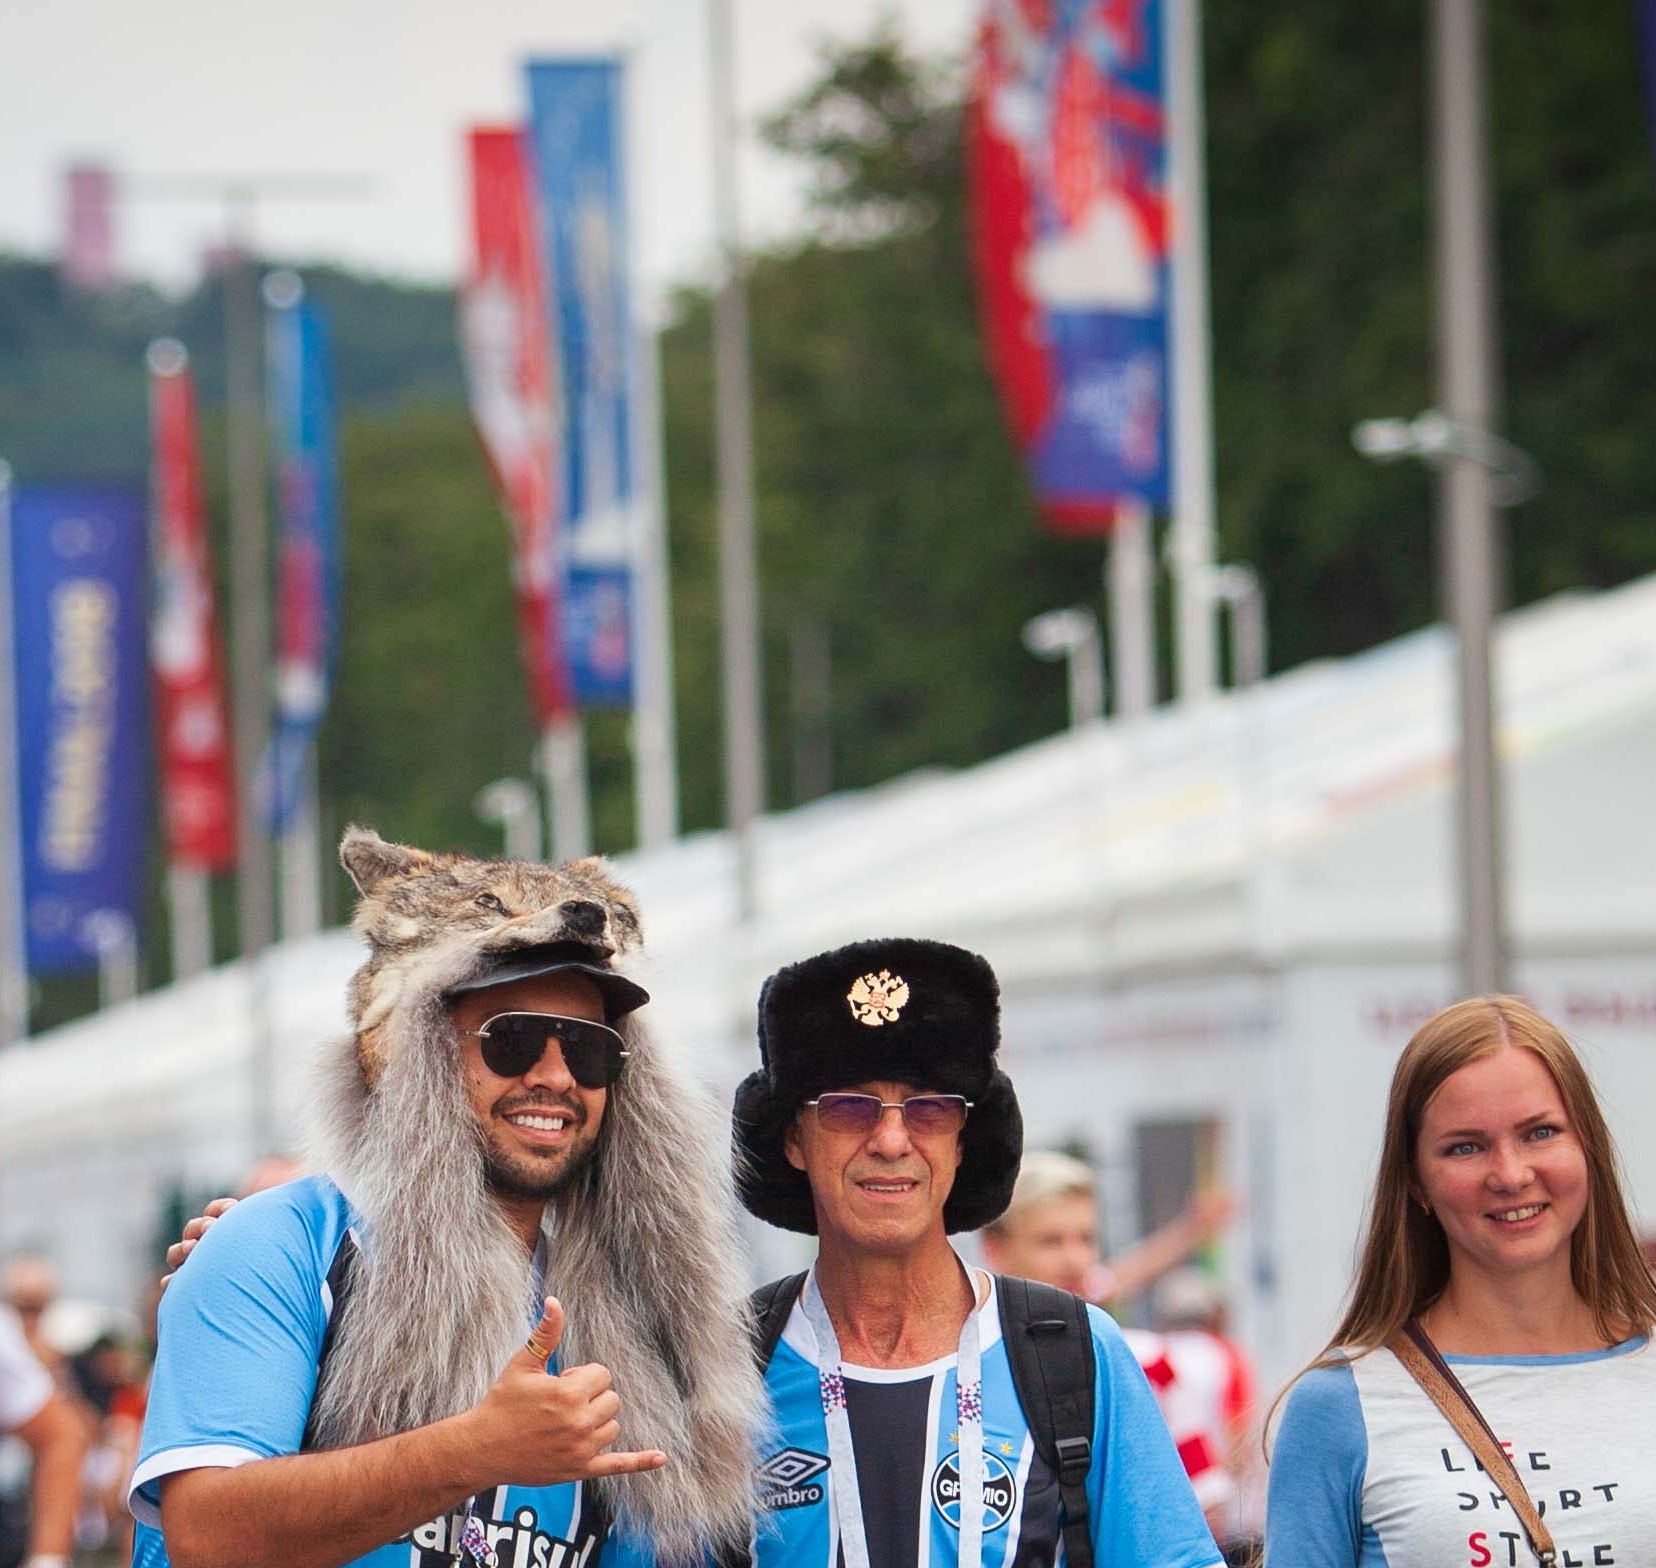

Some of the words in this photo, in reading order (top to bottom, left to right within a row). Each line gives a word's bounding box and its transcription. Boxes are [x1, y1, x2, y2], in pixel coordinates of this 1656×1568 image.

[939, 1479, 1009, 1507] GRMIO
[1457, 1483, 1619, 1520] SRT
[1468, 1531, 1615, 1568] STLE
